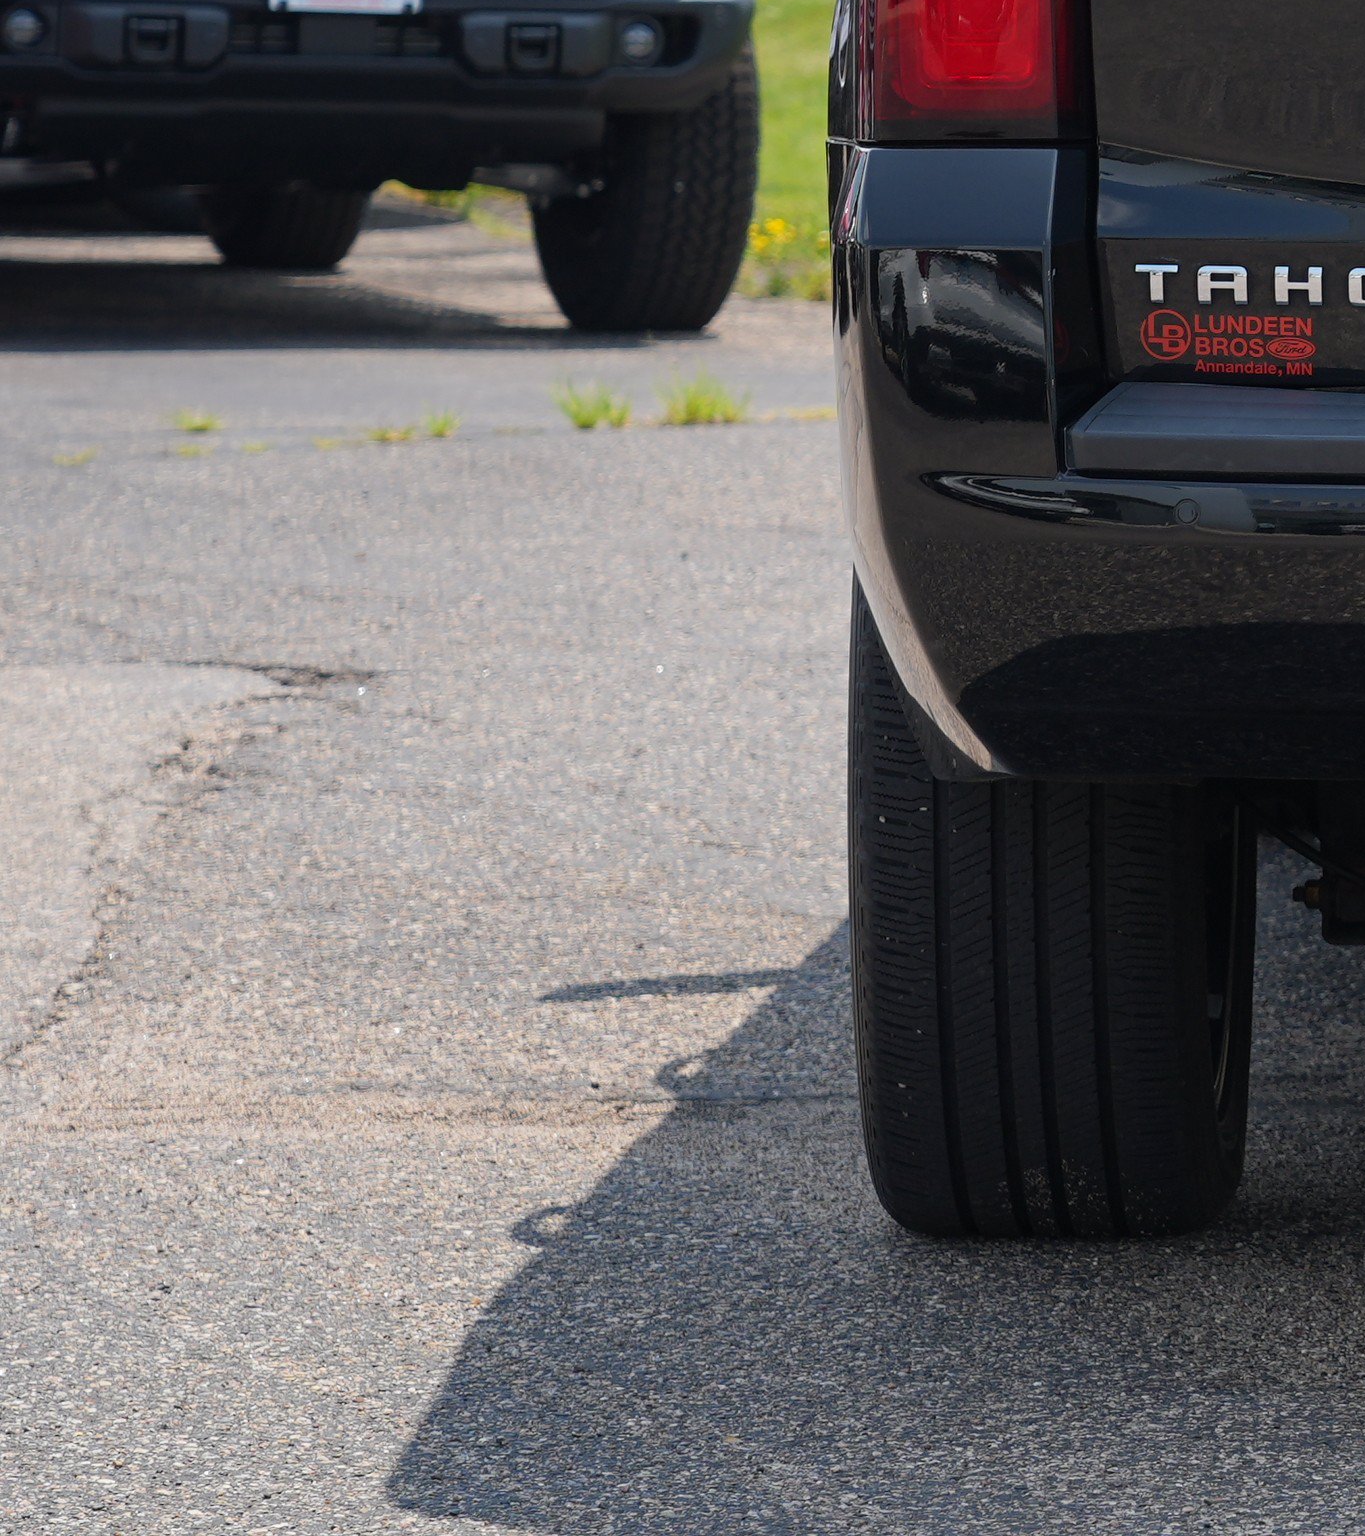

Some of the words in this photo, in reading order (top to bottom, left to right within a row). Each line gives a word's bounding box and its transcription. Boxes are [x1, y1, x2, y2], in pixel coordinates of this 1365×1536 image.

[1194, 314, 1313, 337] LUNDEEN
[1195, 337, 1264, 357] BROS
[1195, 359, 1283, 377] Annandale,
[1286, 362, 1313, 376] MN
